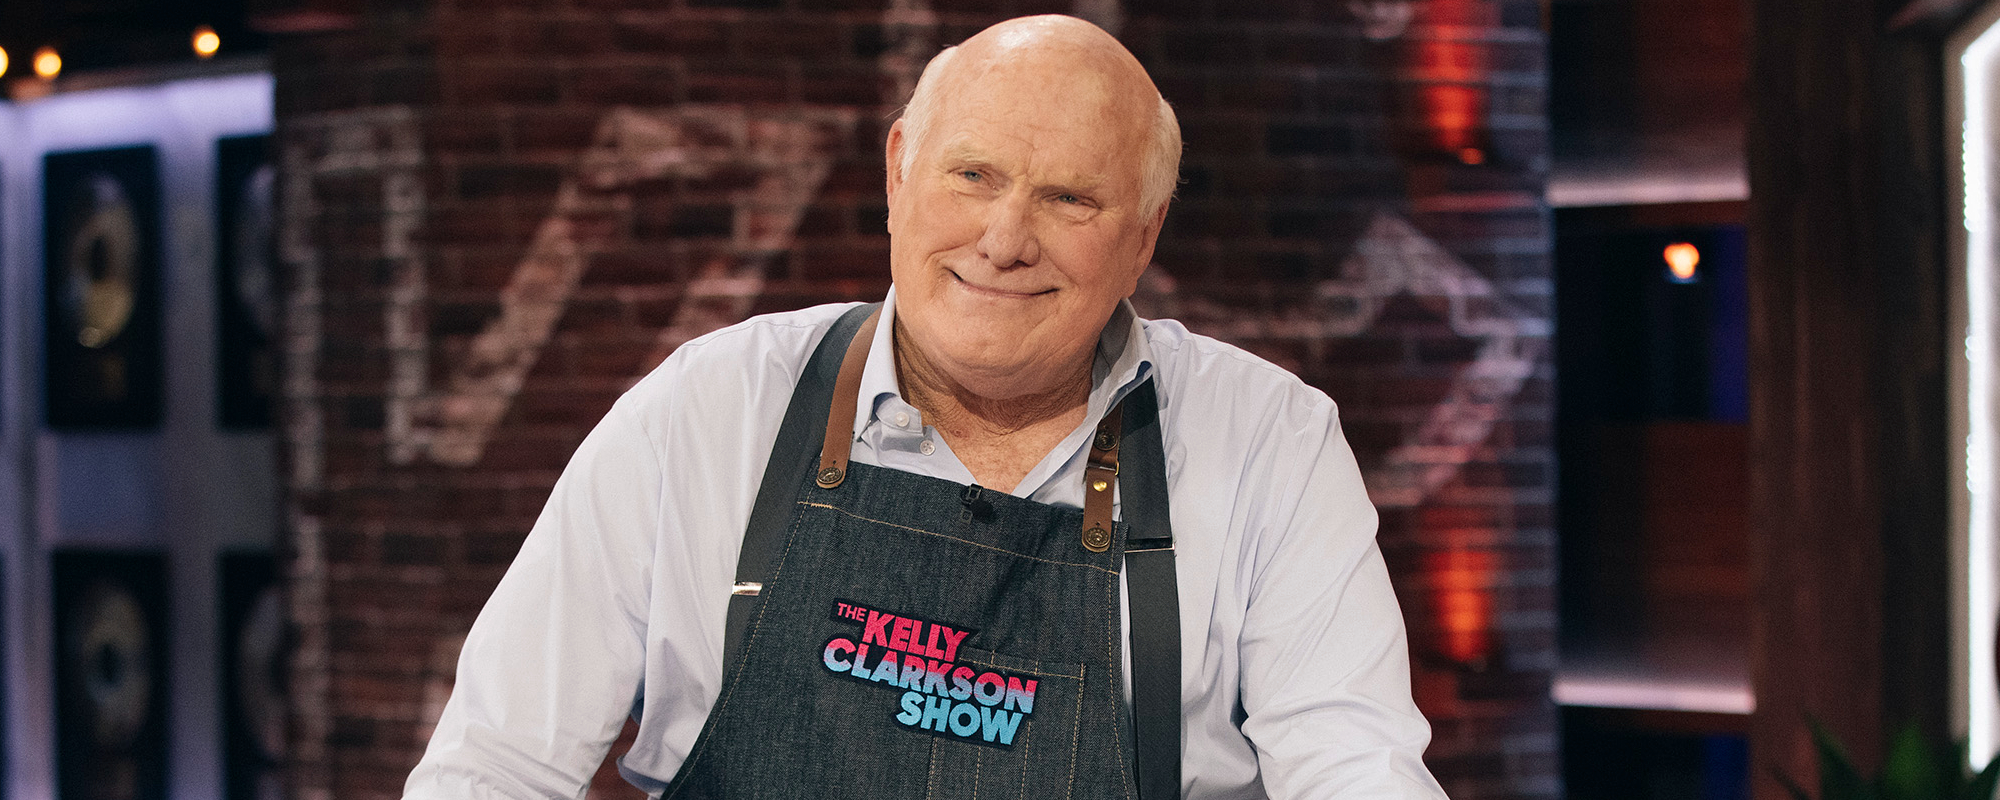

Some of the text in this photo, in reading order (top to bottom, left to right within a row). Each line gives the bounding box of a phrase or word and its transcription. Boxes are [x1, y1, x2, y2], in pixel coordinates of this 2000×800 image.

[838, 602, 969, 662] THE KELLY
[823, 638, 1038, 714] CLARKSON
[896, 691, 1023, 745] SHOW
